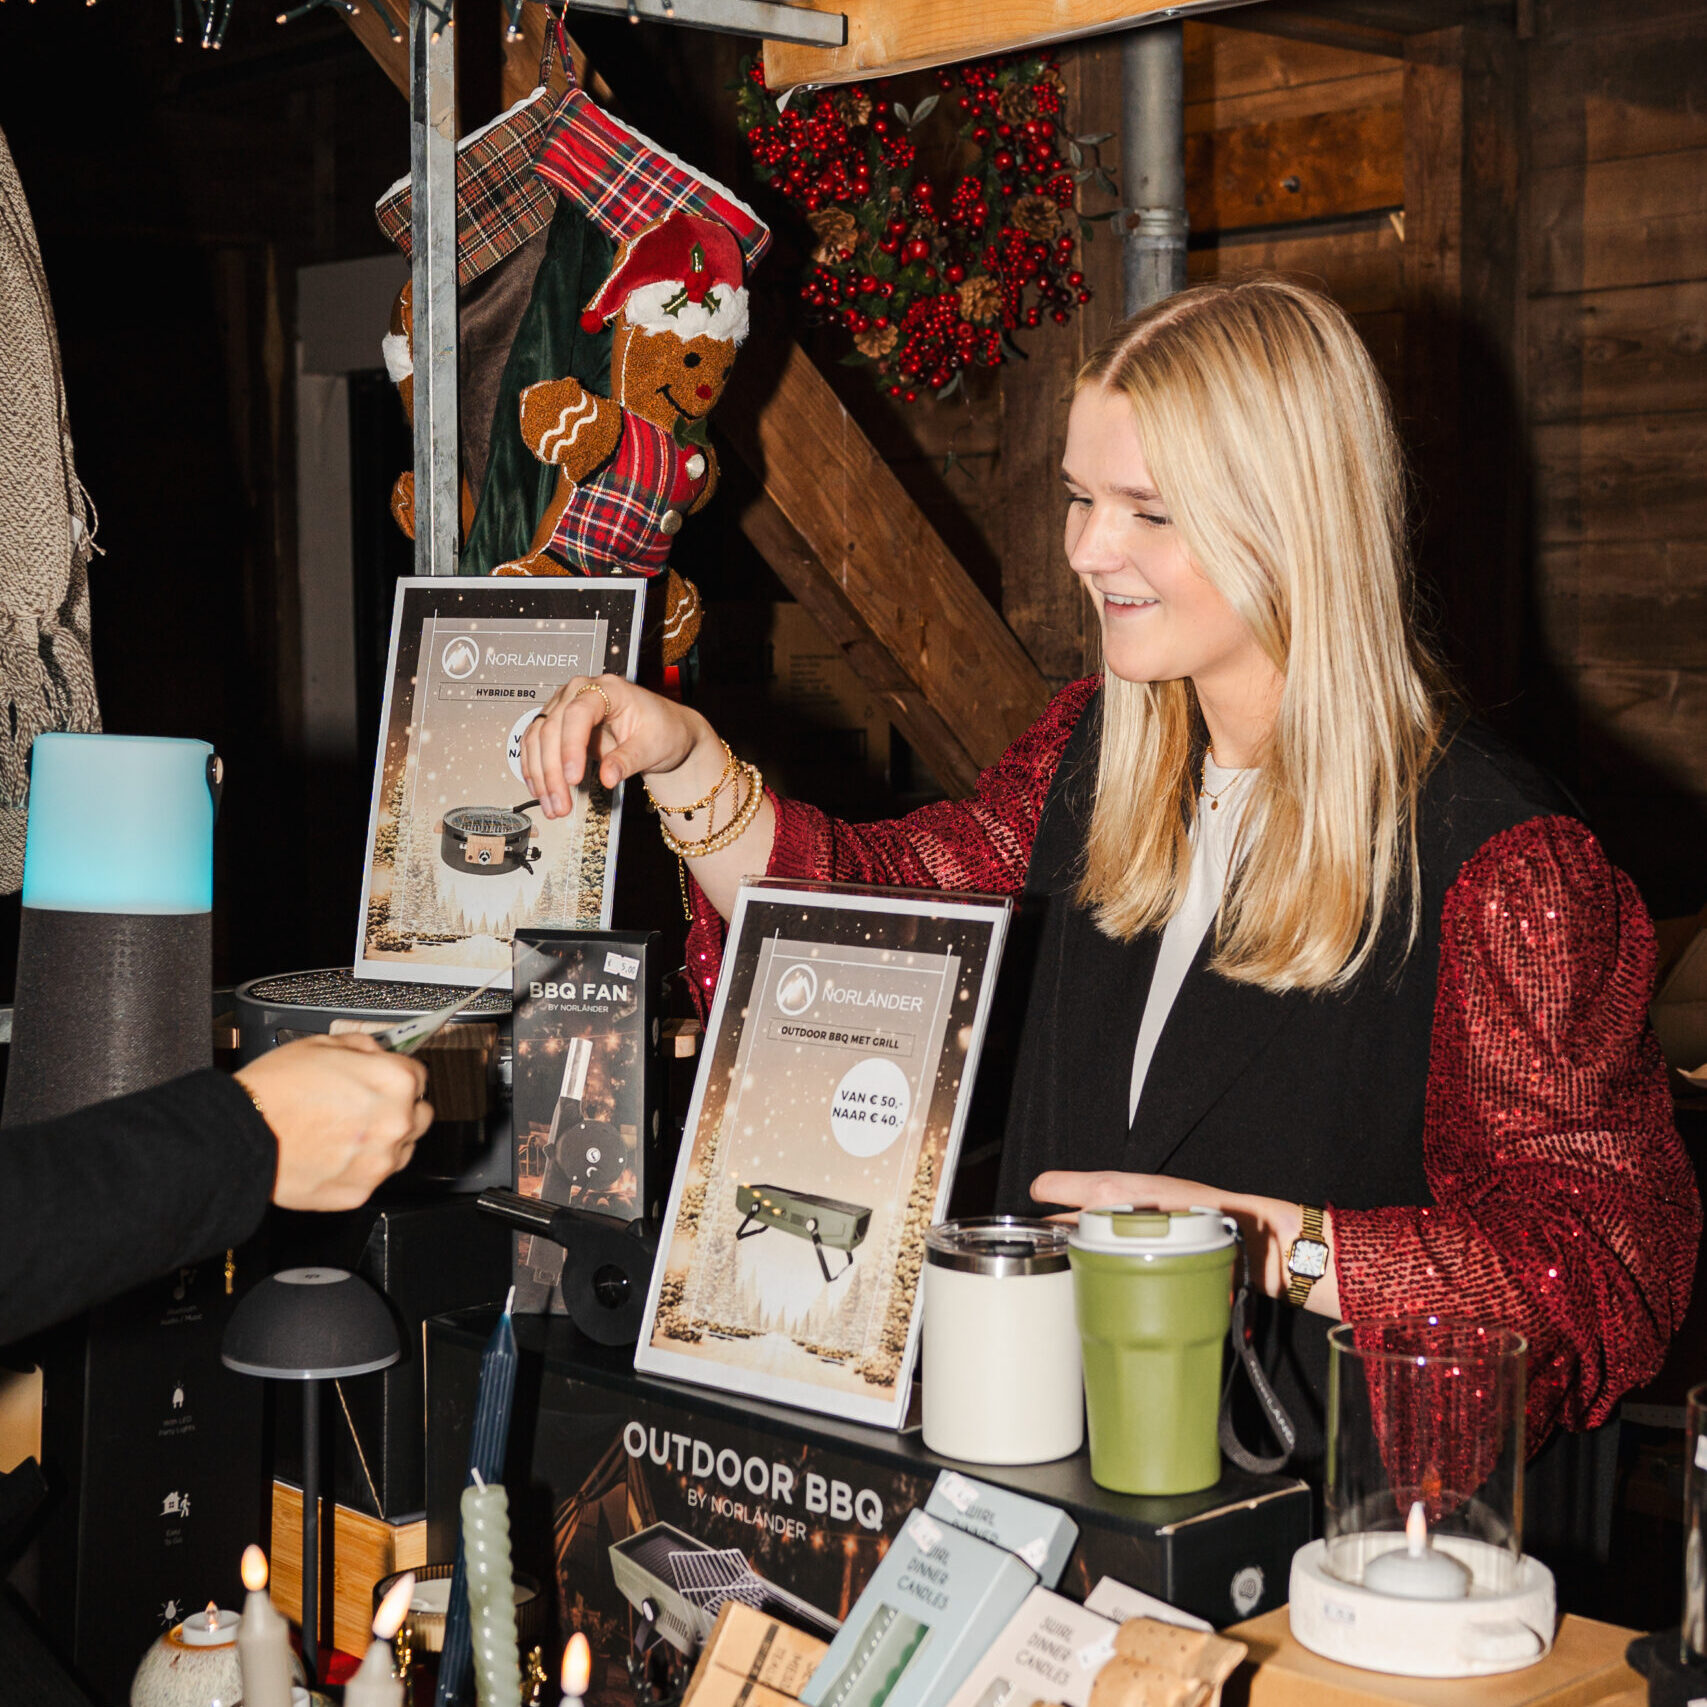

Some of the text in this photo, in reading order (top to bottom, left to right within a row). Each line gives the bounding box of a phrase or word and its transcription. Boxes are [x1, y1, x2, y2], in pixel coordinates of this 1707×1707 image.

[484, 651, 579, 667] NORLÄNDER
[476, 689, 536, 698] HYBRIDE BBQ
[529, 981, 628, 1001] BBQ FAN
[822, 987, 923, 1012] NORLÄNDER
[781, 1026, 899, 1049] OUTDOOR BBQ MET GRILL
[841, 1090, 866, 1103] VAN
[869, 1094, 878, 1105] €
[832, 1107, 866, 1121] NAAR
[869, 1112, 878, 1123] €
[623, 1421, 793, 1504] OUTDOOR
[805, 1472, 884, 1532] BBQ
[687, 1488, 707, 1506] BY
[906, 1554, 949, 1585] DINNER
[897, 1573, 949, 1612] CANDLES
[1027, 1631, 1071, 1662] DINNER
[1014, 1648, 1070, 1687] CANDLES
